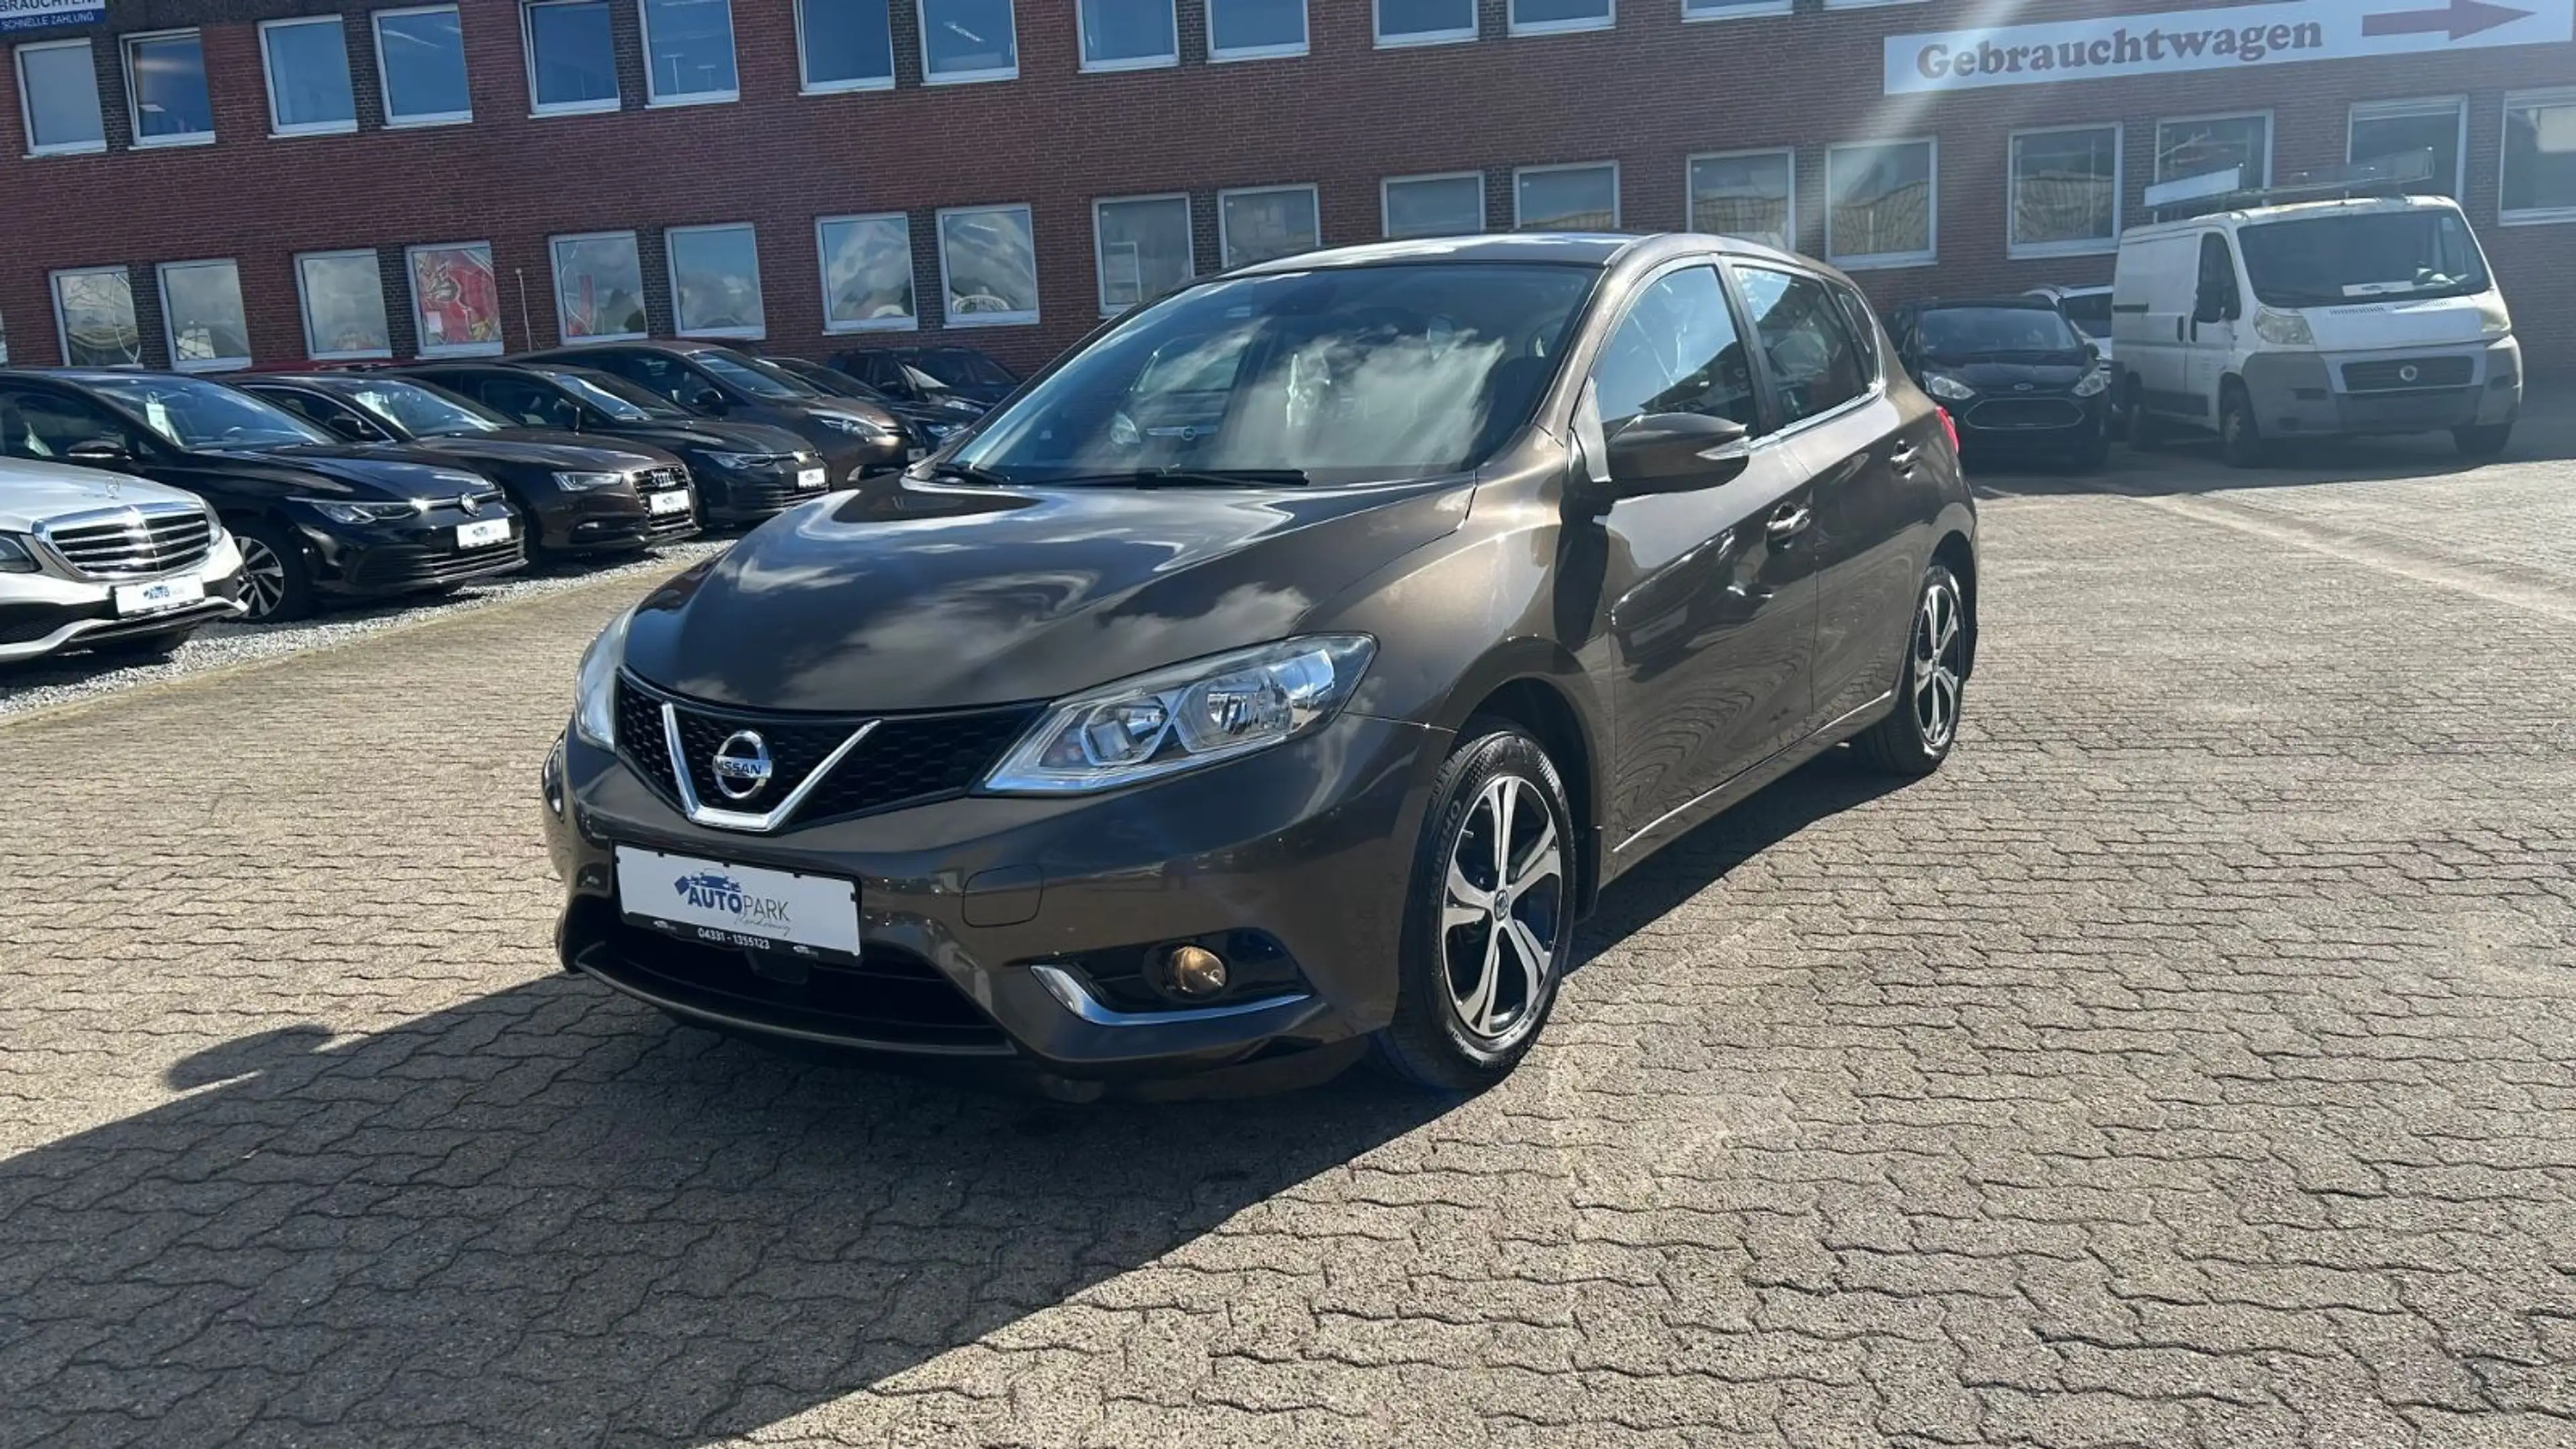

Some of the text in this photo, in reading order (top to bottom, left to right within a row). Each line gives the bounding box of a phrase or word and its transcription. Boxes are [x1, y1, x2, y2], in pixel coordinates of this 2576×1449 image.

[2, 11, 95, 30] SCHNELLE ZAHLUNG
[1917, 21, 2322, 78] Gebrauchtwagen
[687, 887, 790, 922] AUTOPARK
